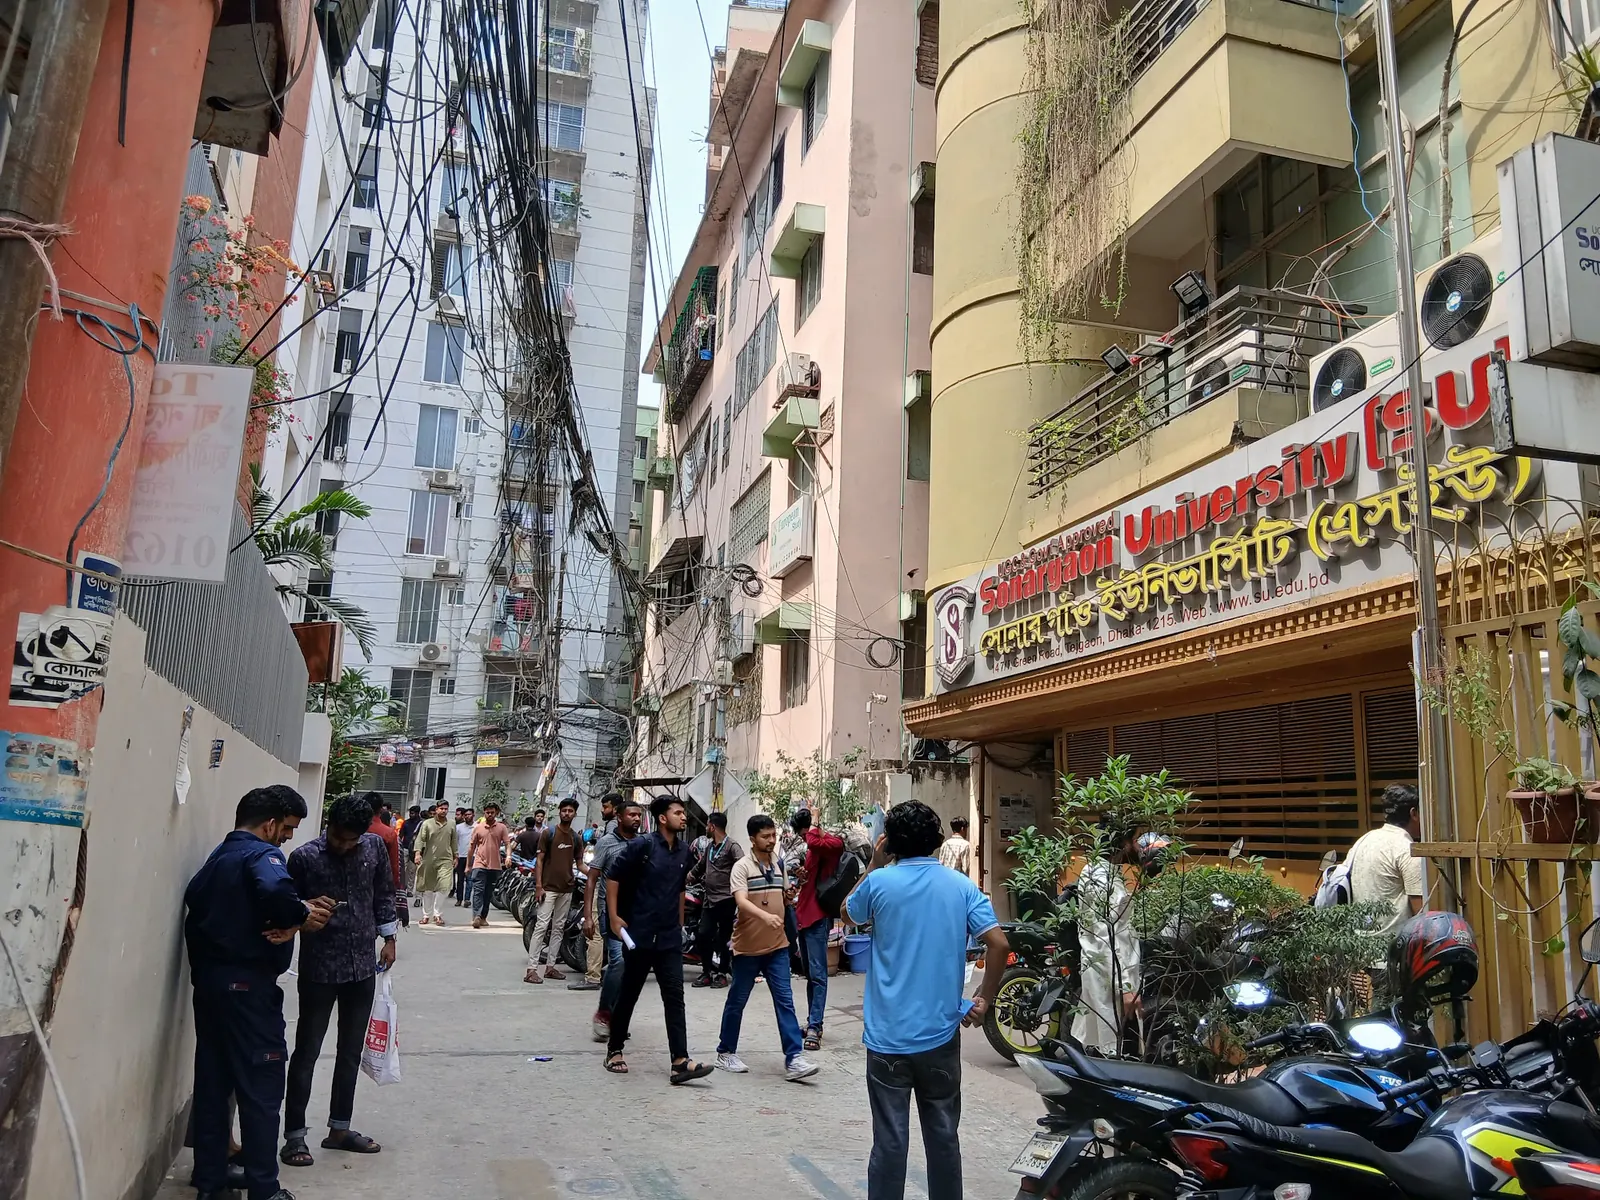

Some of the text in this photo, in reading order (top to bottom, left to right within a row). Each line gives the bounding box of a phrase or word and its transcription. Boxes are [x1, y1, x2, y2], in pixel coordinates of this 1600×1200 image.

[980, 336, 1511, 615] Sonargaon University (SU
[1058, 511, 1115, 551] Approved
[1095, 516, 1293, 622] ইউনিভার্সিটি
[1013, 654, 1038, 669] Green
[1217, 569, 1330, 613] www.su.edu.bd
[44, 661, 98, 678] কোদাল
[1114, 1091, 1137, 1103] 125
[1377, 1074, 1402, 1087] TVS
